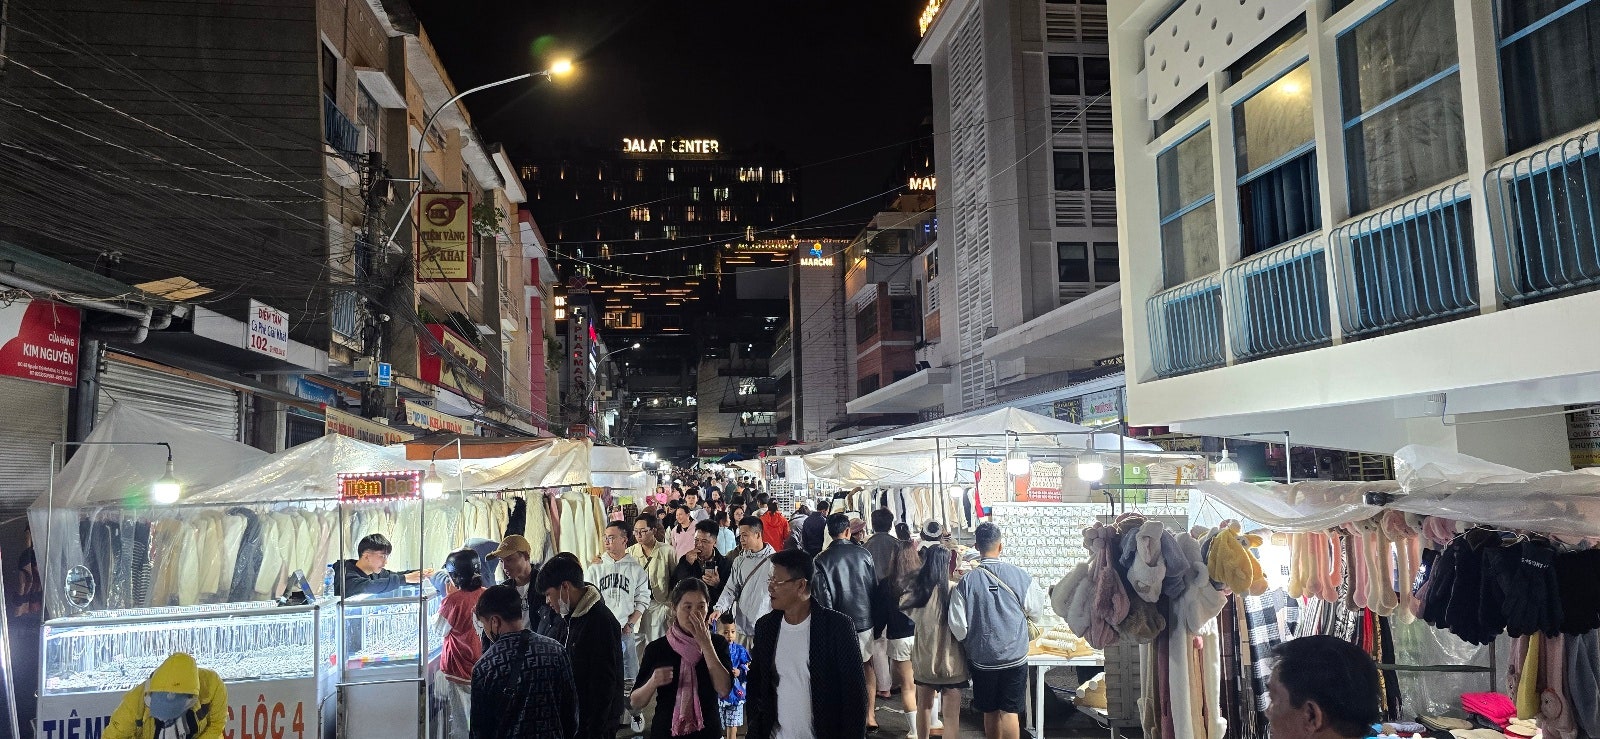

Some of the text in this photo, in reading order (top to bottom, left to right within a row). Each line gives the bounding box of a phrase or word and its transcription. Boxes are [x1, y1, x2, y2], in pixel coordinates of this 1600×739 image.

[671, 139, 719, 153] CENTER
[443, 229, 465, 241] VÀNG
[23, 343, 39, 358] KIM
[251, 334, 268, 351] 102
[343, 479, 382, 499] Tiệm
[292, 701, 305, 739] 4
